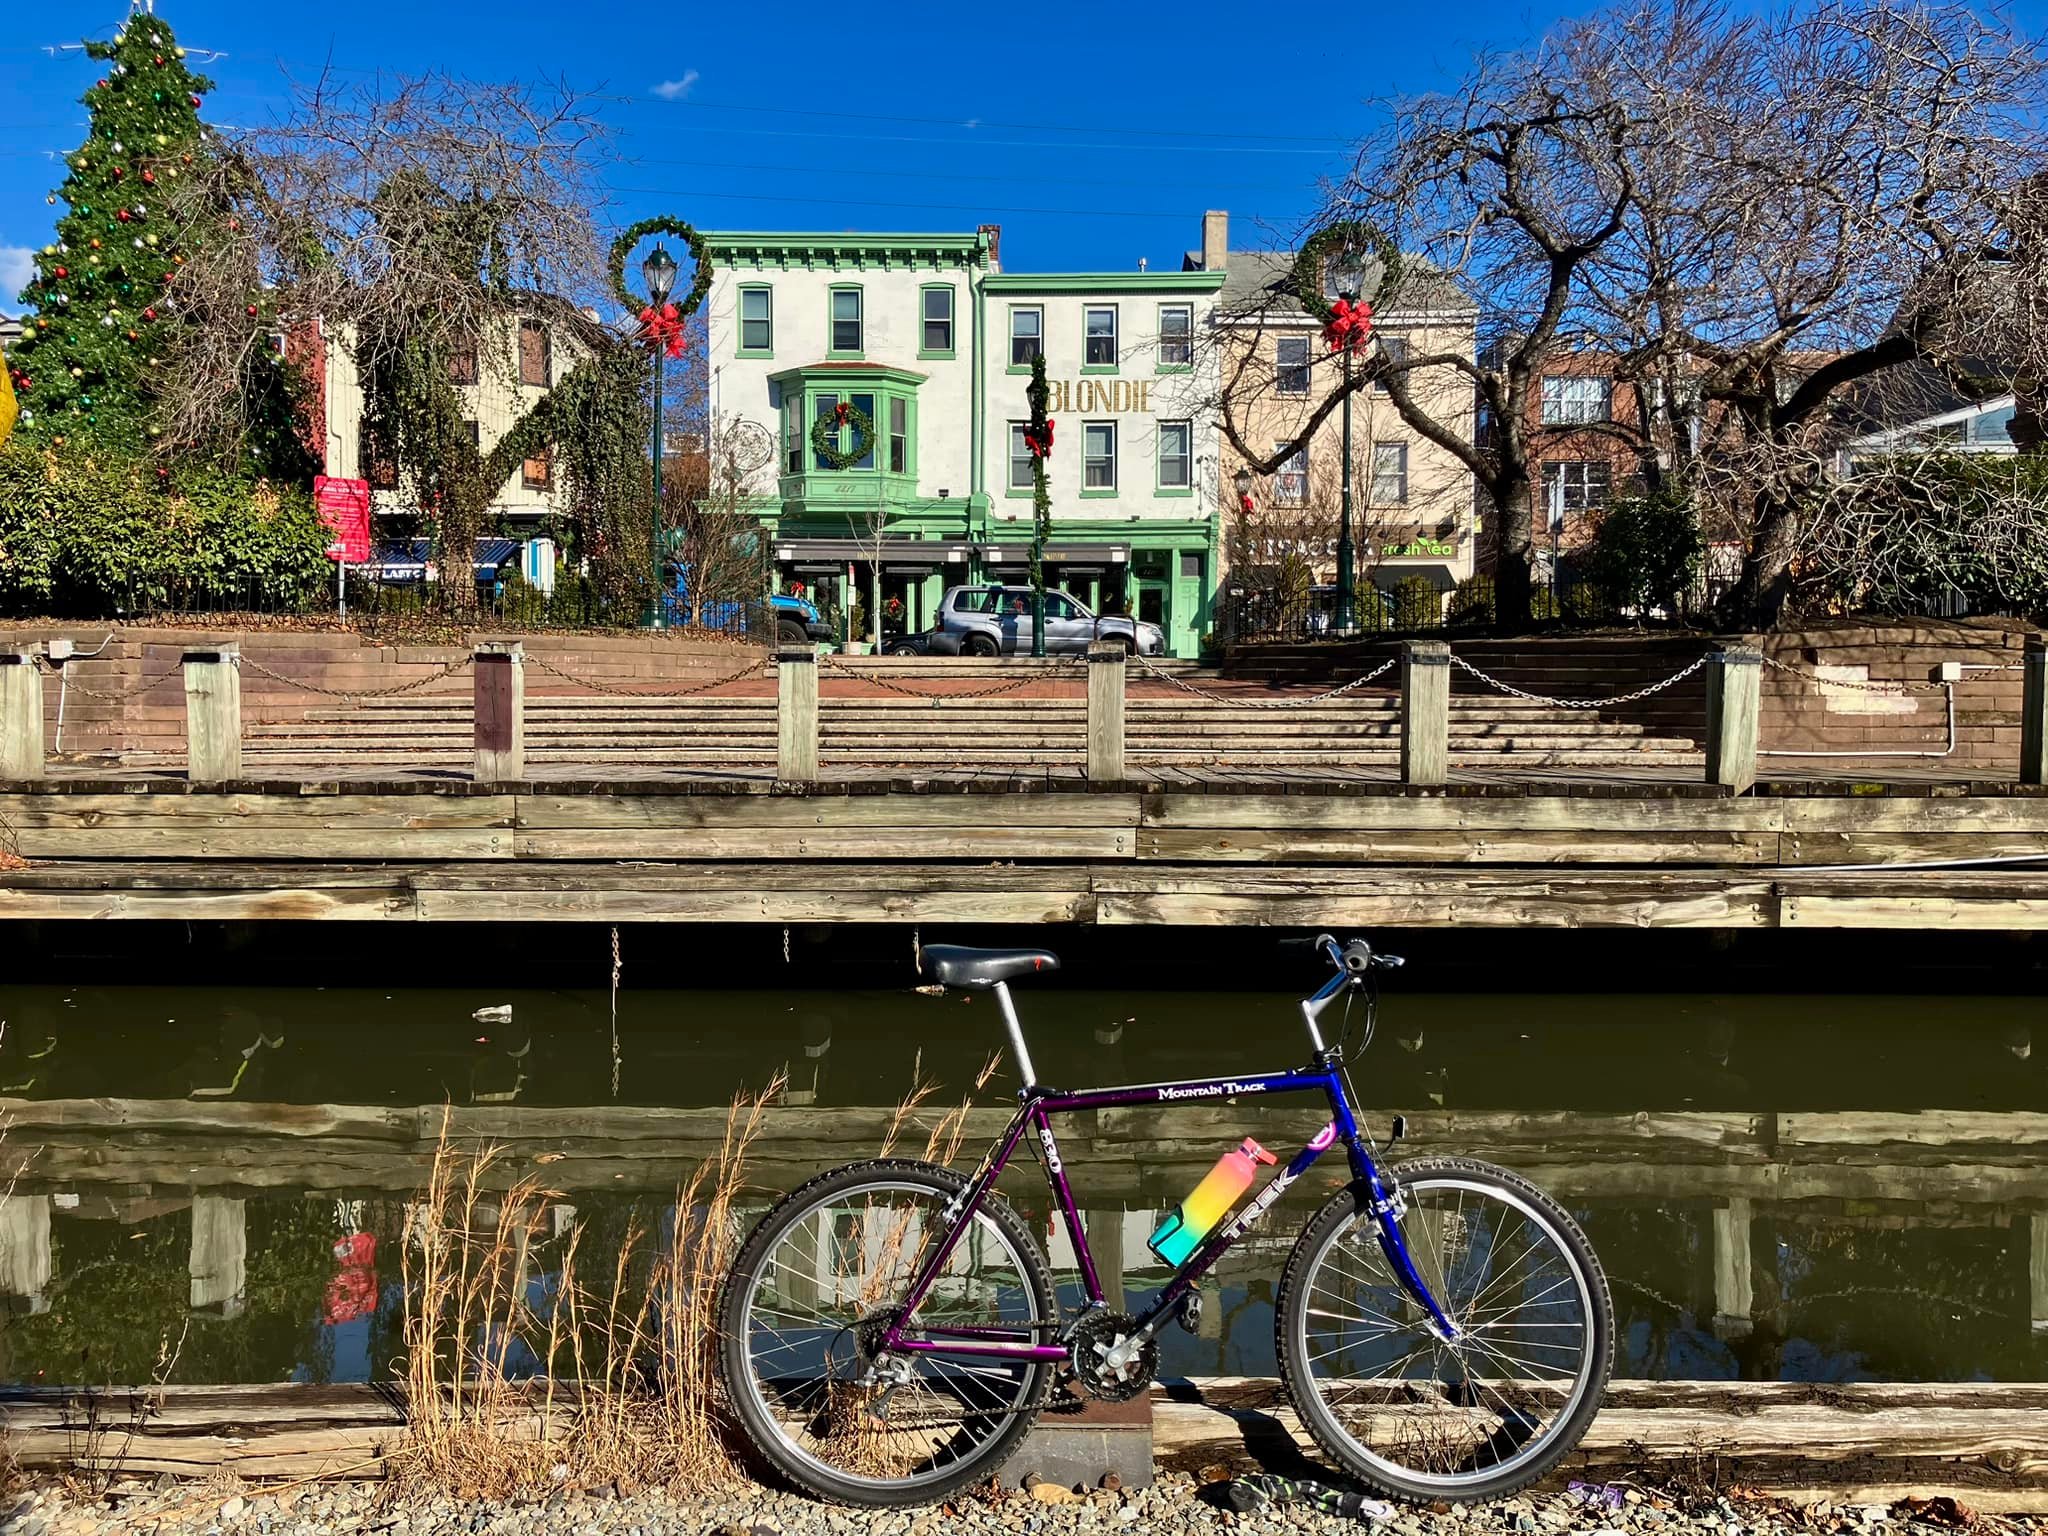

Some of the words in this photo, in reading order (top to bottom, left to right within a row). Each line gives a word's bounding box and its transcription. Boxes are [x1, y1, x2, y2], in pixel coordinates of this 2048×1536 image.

[1046, 380, 1155, 413] BLONDIE
[1223, 1082, 1266, 1095] TRACK
[1040, 1128, 1062, 1173] 830
[1221, 1165, 1298, 1239] TREK
